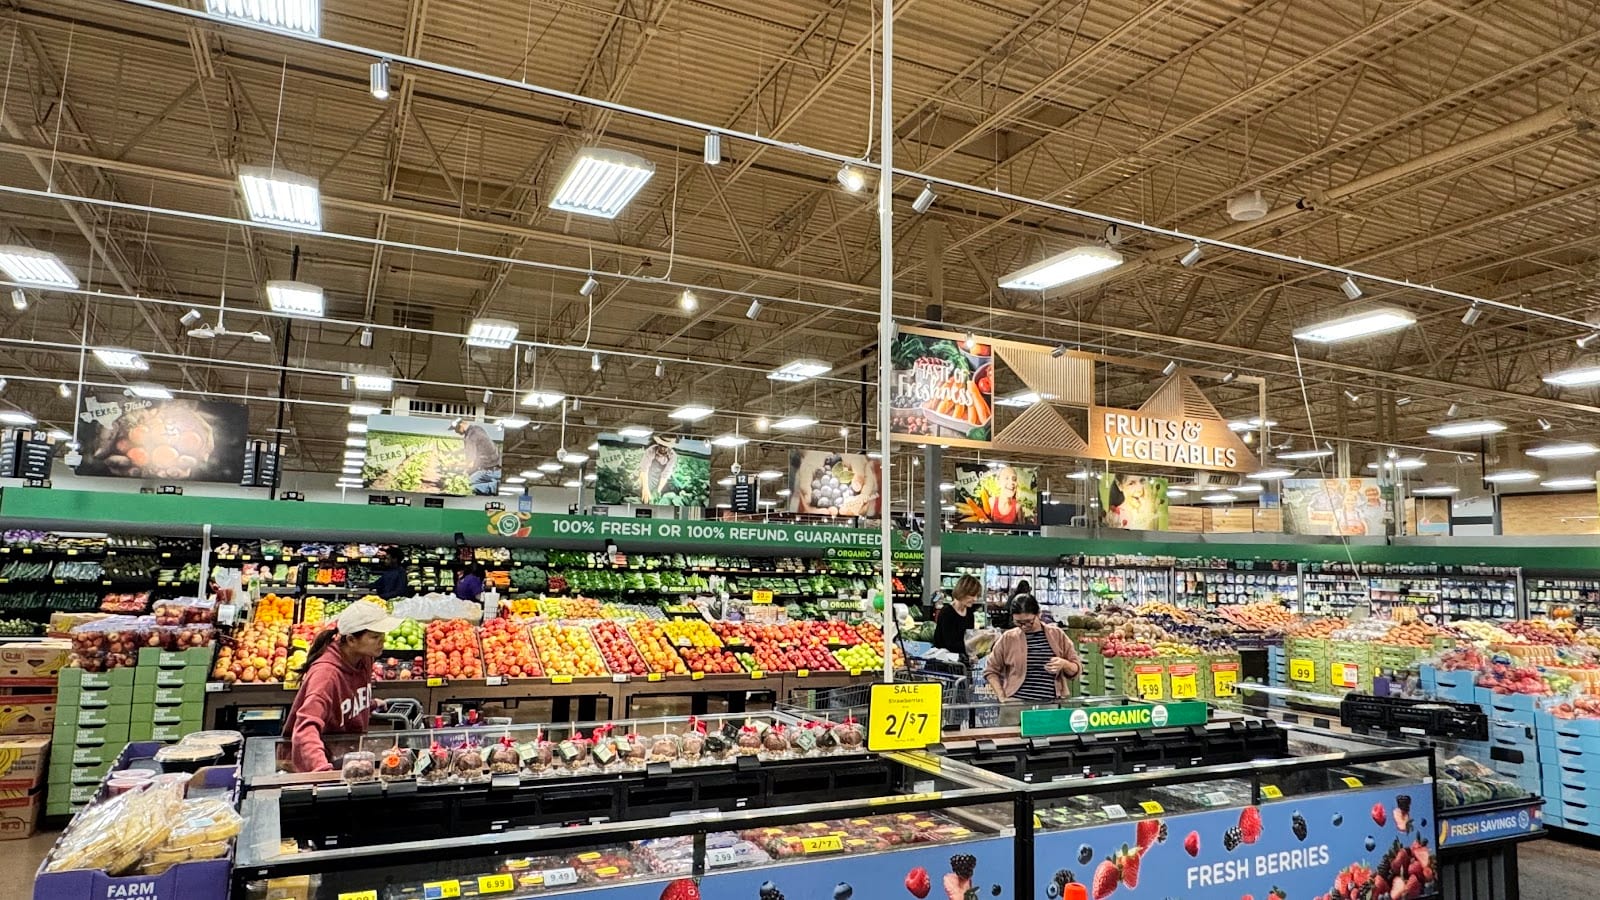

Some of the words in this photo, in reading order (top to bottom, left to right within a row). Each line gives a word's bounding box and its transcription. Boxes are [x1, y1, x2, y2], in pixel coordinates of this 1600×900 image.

[919, 361, 955, 383] TASTE
[898, 373, 973, 406] Freshness
[90, 406, 118, 418] TEXAS
[1103, 413, 1178, 441] FRUITS
[1182, 420, 1202, 443] &
[34, 432, 46, 441] 20
[375, 450, 401, 461] TEXAS
[1105, 435, 1236, 467] VEGETABLES
[738, 475, 746, 483] 12
[552, 519, 595, 534] 100%
[601, 522, 652, 536] FRESH
[658, 524, 682, 538] OR
[687, 525, 725, 539] 100%
[729, 527, 789, 542] REFUND.
[794, 530, 882, 546] GUARANTEED
[837, 549, 871, 558] ORGANIC
[894, 685, 919, 694] SALE
[885, 711, 928, 739] 2/$7
[1089, 708, 1151, 726] ORGANIC
[1450, 824, 1479, 837] FRESH
[1480, 816, 1517, 832] SAVINGS
[715, 853, 731, 862] 2.99
[1187, 858, 1249, 889] FRESH
[1255, 844, 1330, 876] BERRIES
[486, 880, 505, 889] 6.99
[550, 873, 570, 882] 9.49
[107, 882, 155, 898] FARM
